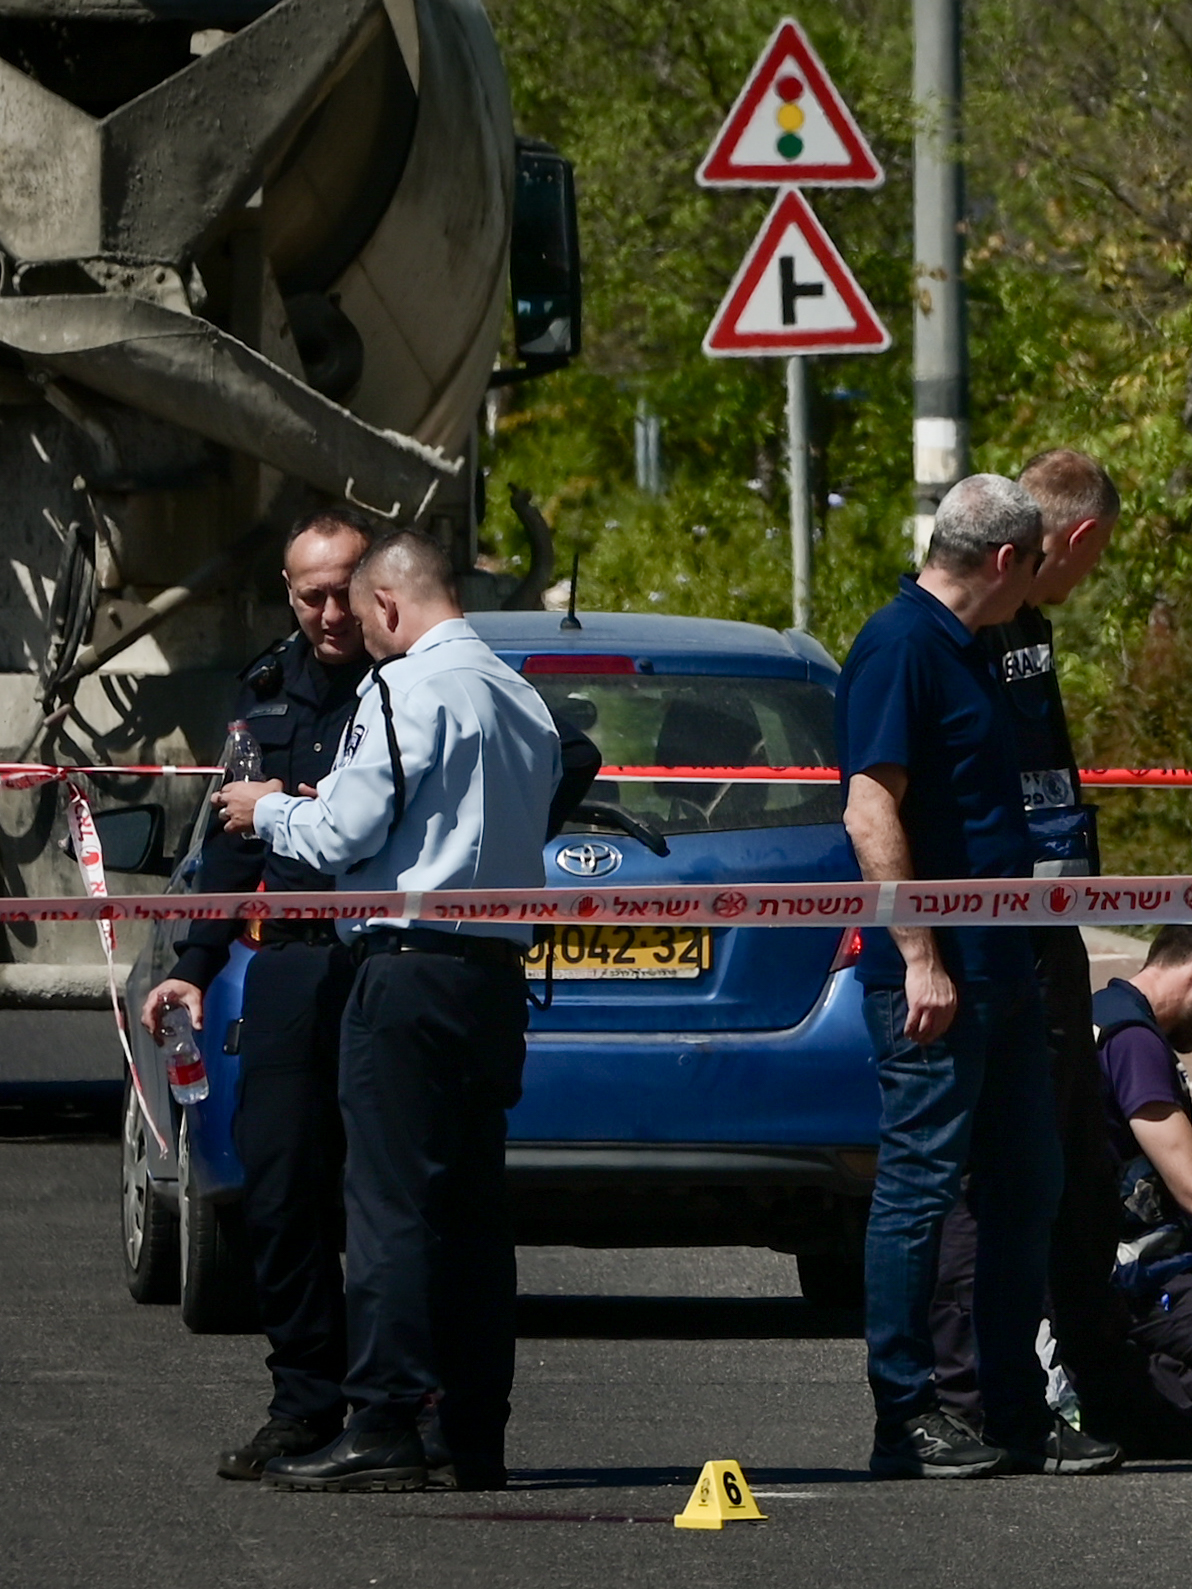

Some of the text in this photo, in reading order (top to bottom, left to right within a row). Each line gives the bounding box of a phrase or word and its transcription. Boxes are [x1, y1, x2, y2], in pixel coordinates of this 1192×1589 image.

[433, 903, 509, 919] מעבר
[518, 900, 558, 919] אין
[612, 896, 700, 917] ישראל
[756, 893, 864, 917] משטרת
[908, 891, 983, 916] מעבר
[991, 890, 1031, 917] אין
[1085, 886, 1171, 912] ישראל
[723, 1471, 742, 1505] 6
